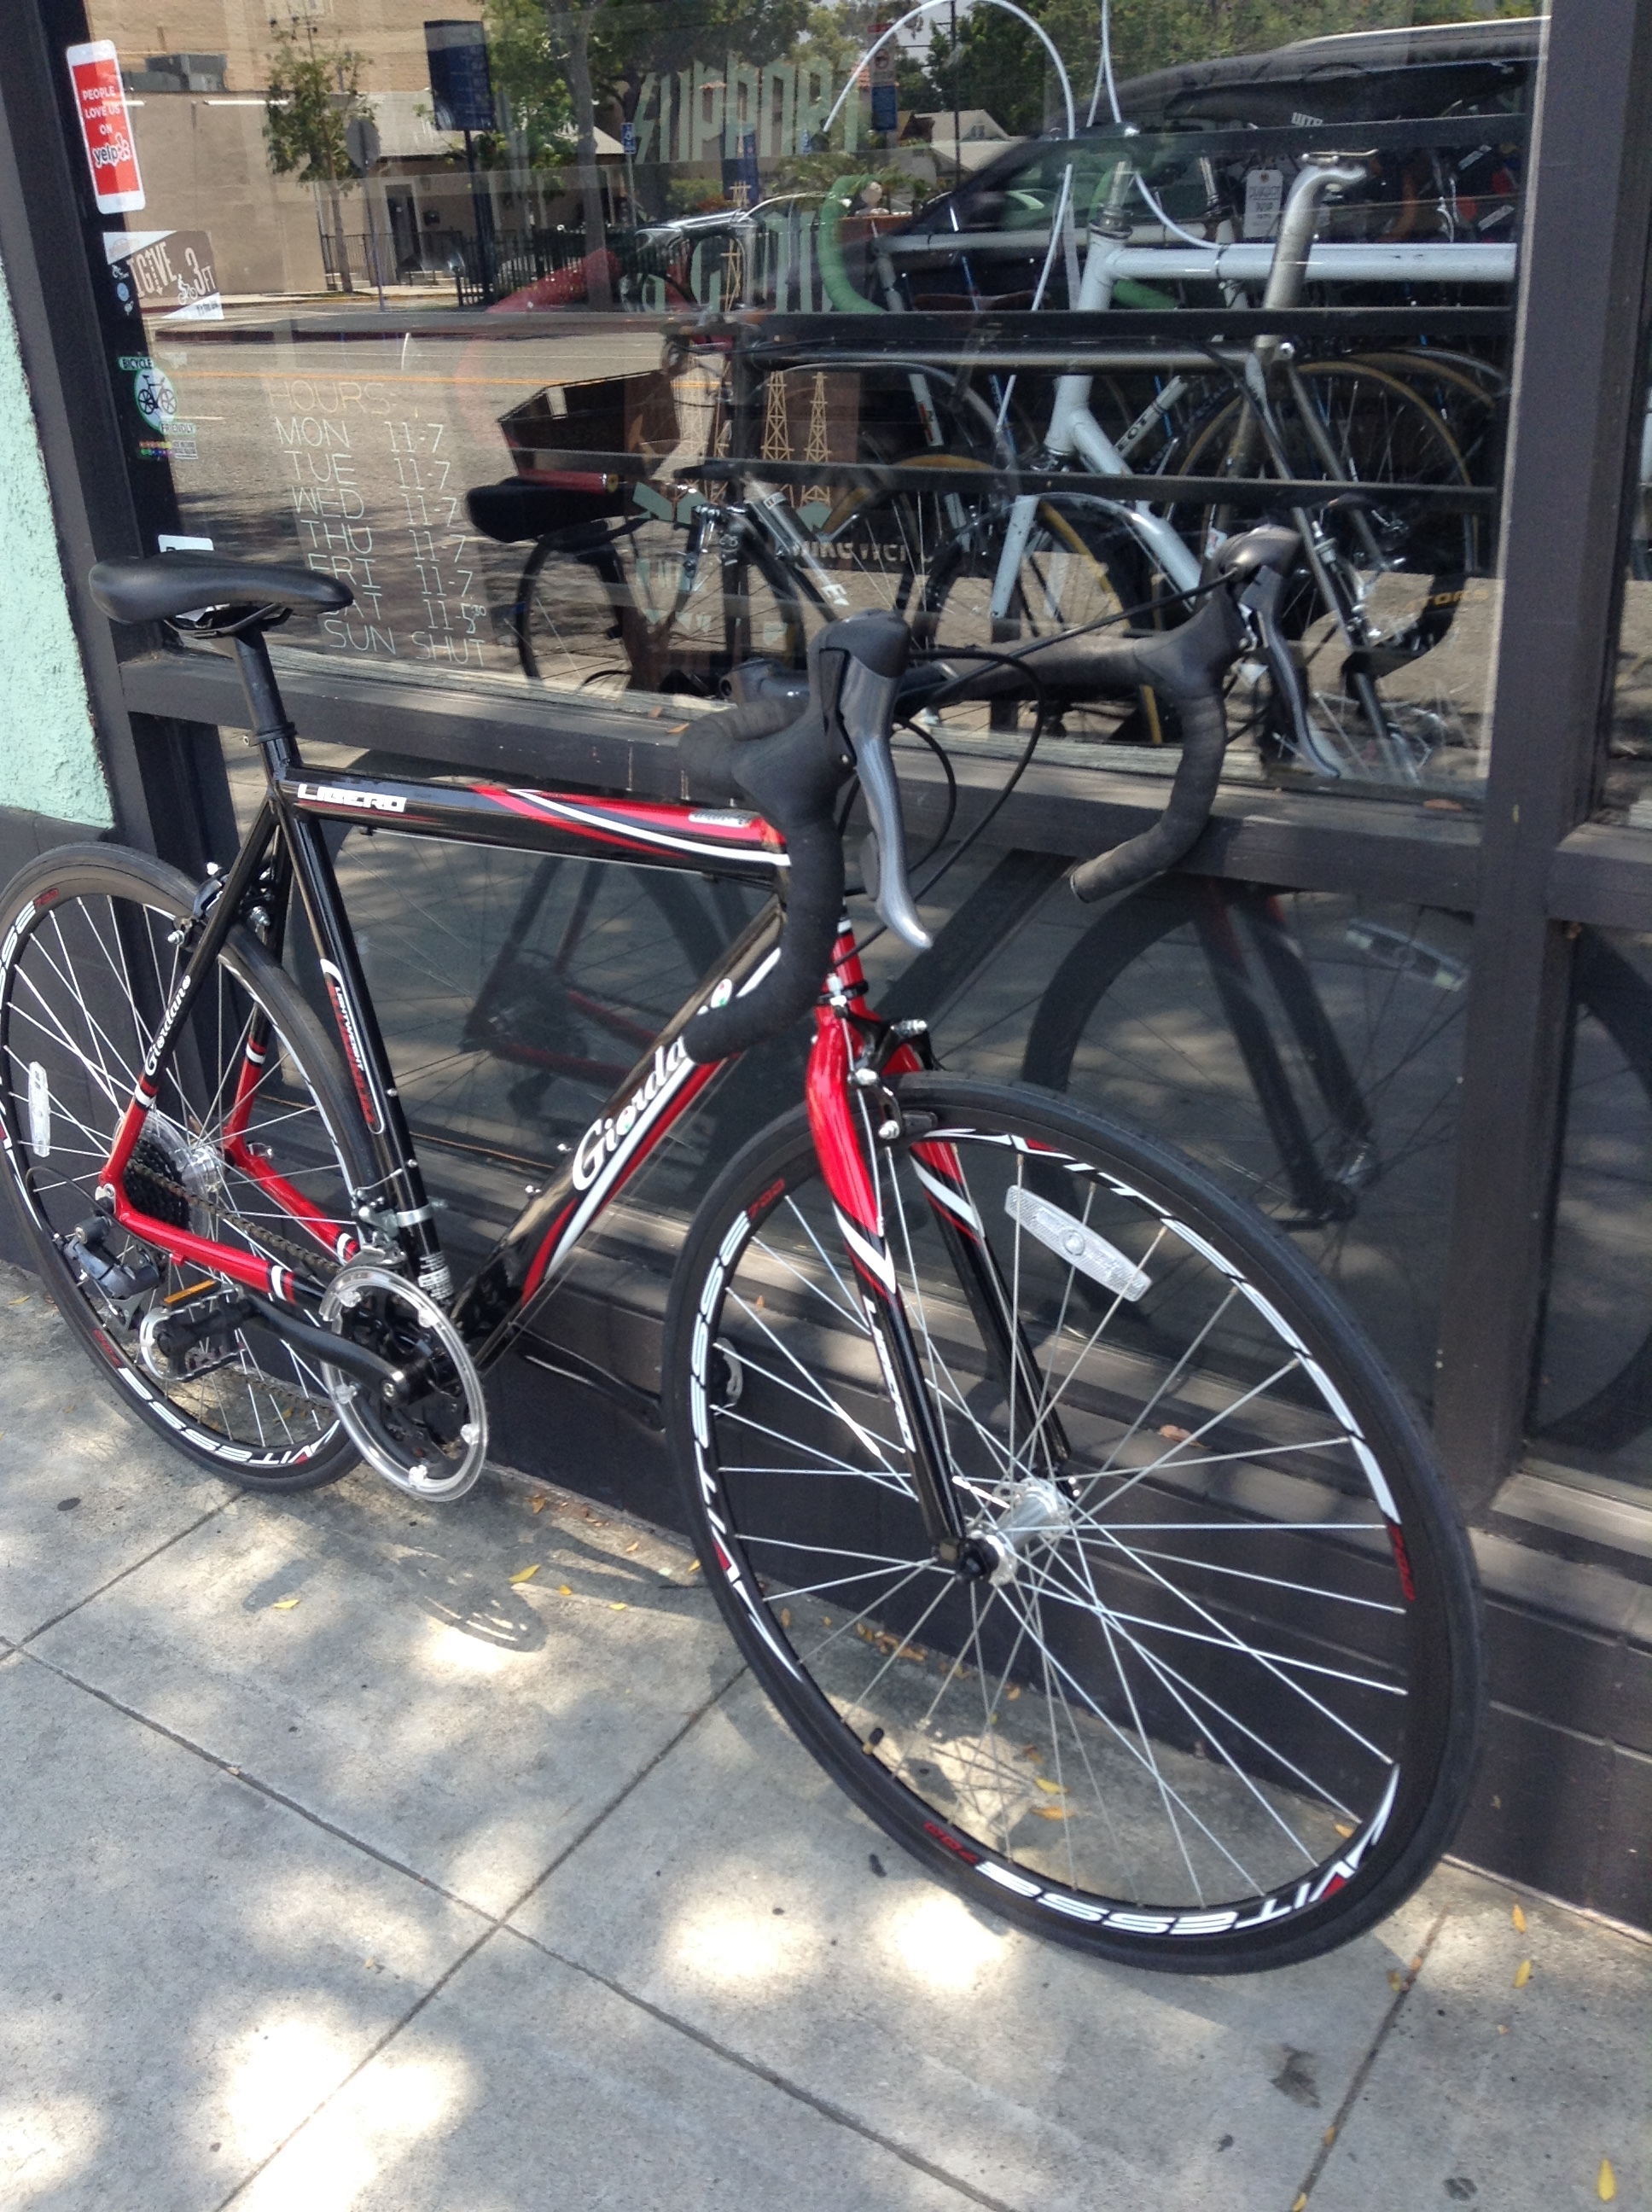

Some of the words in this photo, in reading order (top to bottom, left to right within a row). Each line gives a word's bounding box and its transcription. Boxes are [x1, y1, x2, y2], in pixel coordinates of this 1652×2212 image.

[83, 86, 115, 101] PEOPLE
[85, 106, 108, 119] LOVE
[109, 103, 121, 115] US
[99, 124, 113, 136] ON
[94, 144, 119, 167] yelp
[185, 247, 206, 296] 3
[201, 265, 216, 293] FT
[122, 358, 153, 370] BICYCLE
[275, 416, 350, 448] MON
[384, 422, 444, 454] 11-7
[284, 451, 358, 486] TUE
[393, 458, 451, 490] 11-7
[292, 486, 364, 519] WED
[401, 493, 457, 527] 11-7
[300, 519, 372, 555] THU
[409, 529, 466, 563] 11-7
[308, 553, 381, 589] FRI
[416, 564, 473, 598] 11-7
[323, 592, 382, 621] AT
[323, 620, 397, 655] SUN
[410, 631, 486, 668] SHUT
[297, 783, 408, 813] LIBERO
[144, 975, 192, 1076] Giordano
[572, 978, 733, 1191] Giordao
[947, 1128, 1402, 1526] VITESSE
[862, 1295, 916, 1453] LIBERO
[117, 1367, 340, 1466] VITESSE
[974, 1813, 1378, 1936] VITESSE
